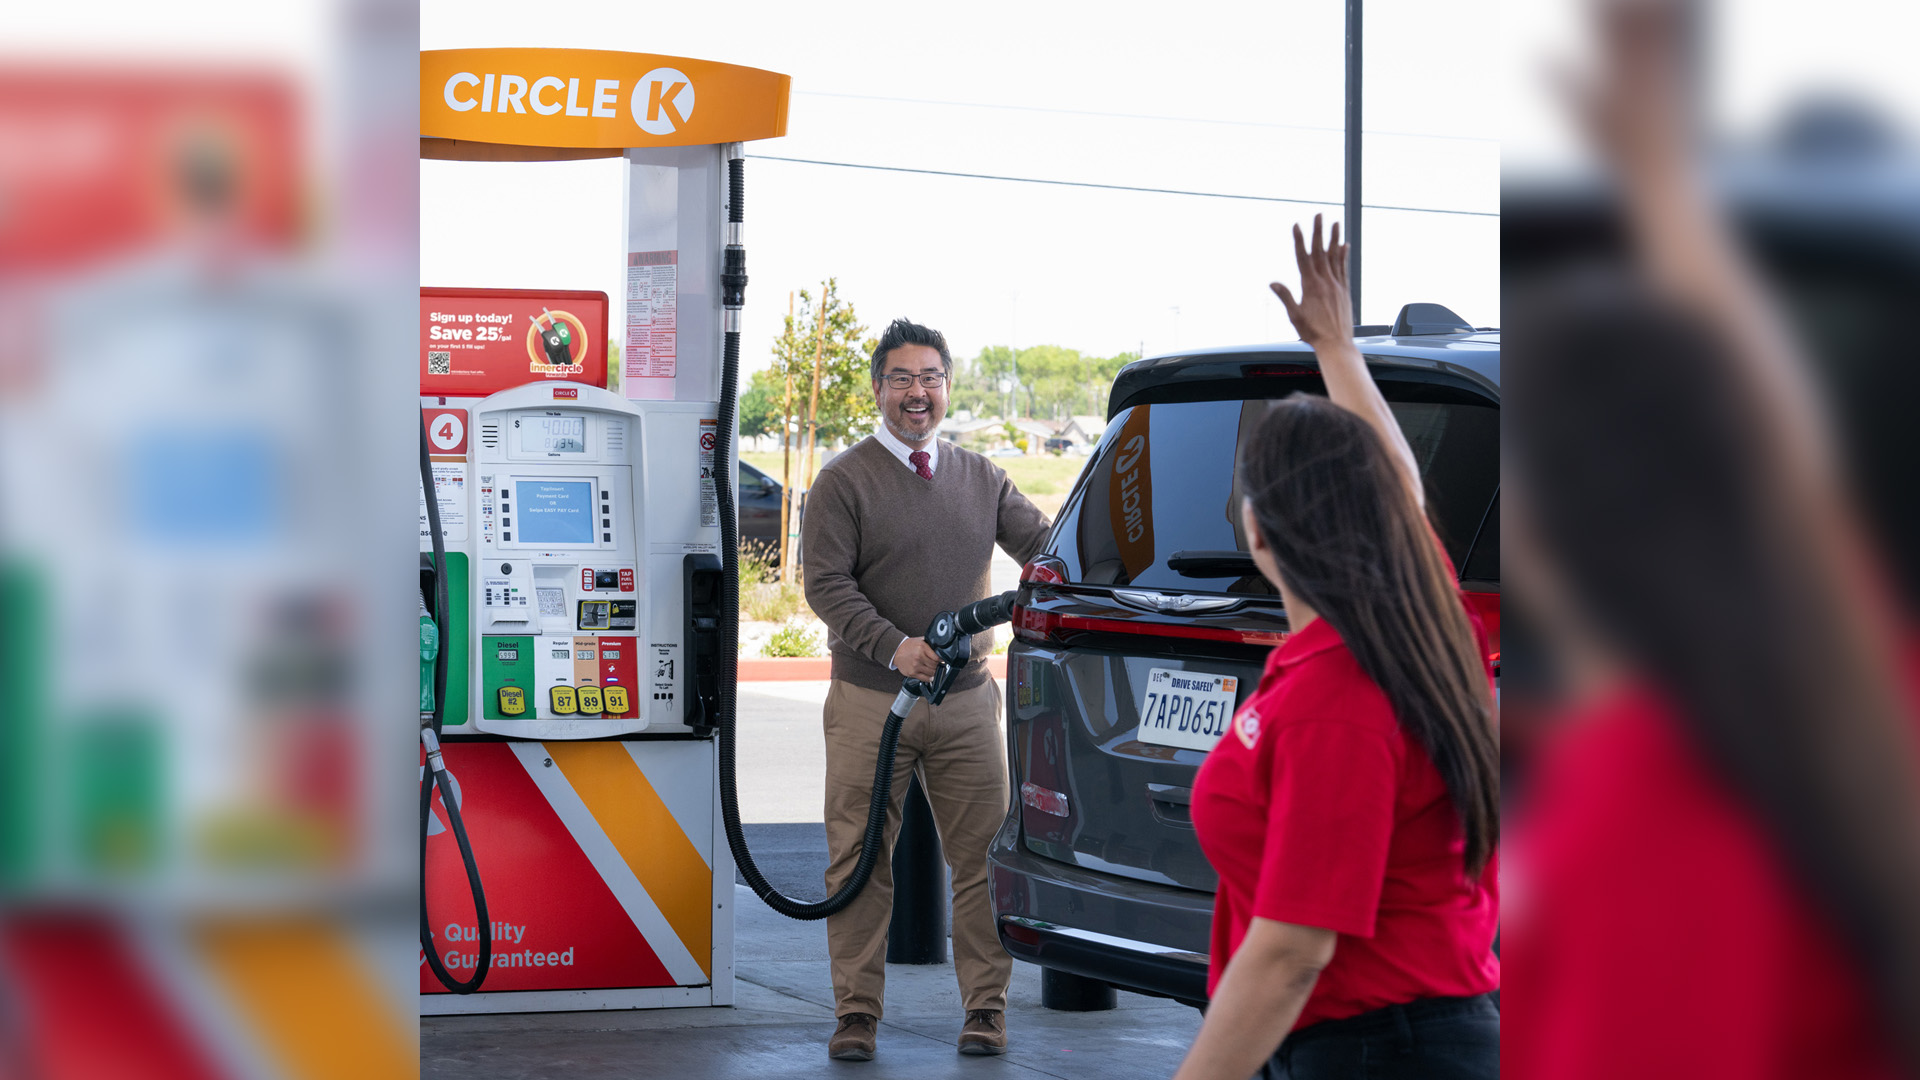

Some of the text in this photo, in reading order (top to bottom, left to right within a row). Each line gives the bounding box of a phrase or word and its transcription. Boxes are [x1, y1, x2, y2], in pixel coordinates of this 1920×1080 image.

[443, 71, 692, 133] CIRCLE K
[430, 312, 513, 325] Sign up today!
[429, 326, 473, 340] Save
[531, 362, 583, 373] innercircle
[514, 419, 520, 428] $
[438, 422, 453, 440] 4
[1152, 673, 1163, 682] DEC
[1171, 677, 1191, 689] DRIVE
[1191, 680, 1214, 692] SAFELY
[501, 690, 522, 698] Diesel
[557, 696, 571, 706] 87
[583, 696, 599, 707] 89
[609, 696, 624, 706] 91
[1144, 692, 1226, 737] 7APD651
[444, 921, 526, 944] Qulity
